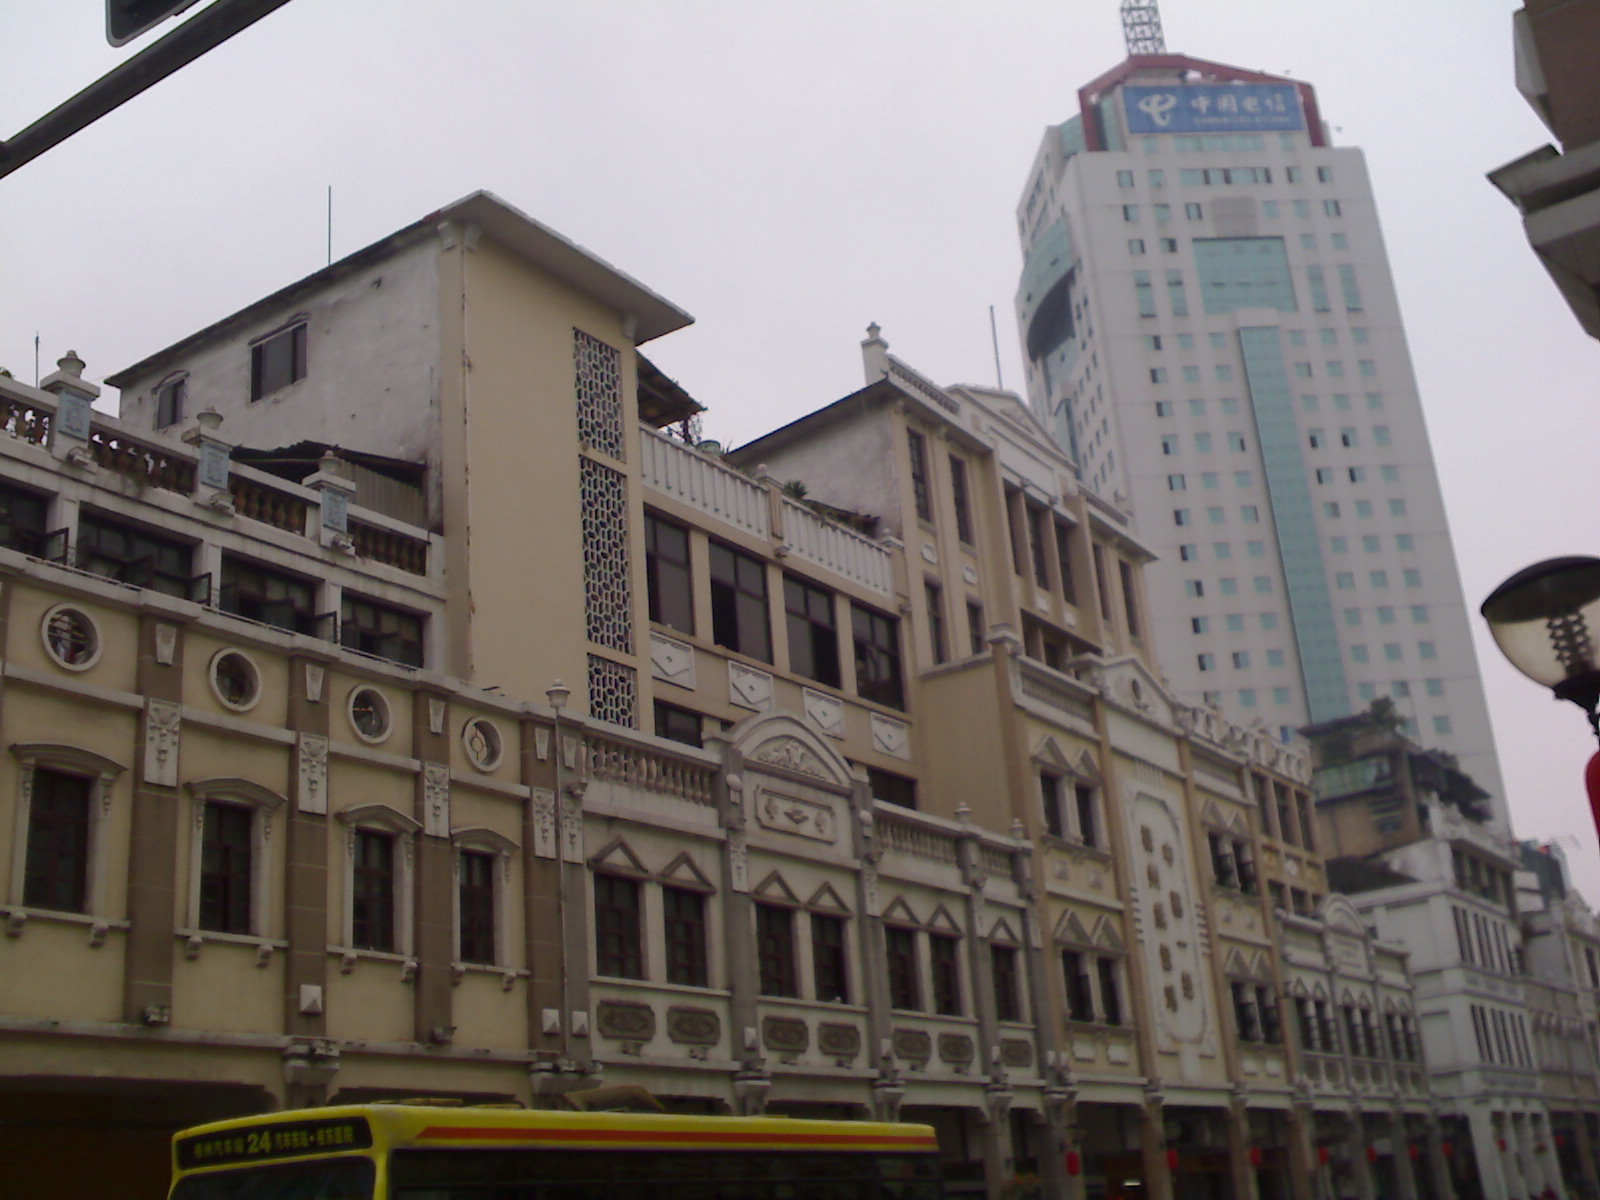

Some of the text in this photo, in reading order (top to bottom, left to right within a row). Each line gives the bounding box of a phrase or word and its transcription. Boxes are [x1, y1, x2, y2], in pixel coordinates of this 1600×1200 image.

[1191, 94, 1286, 113] 中国电信
[248, 1132, 270, 1153] 24
